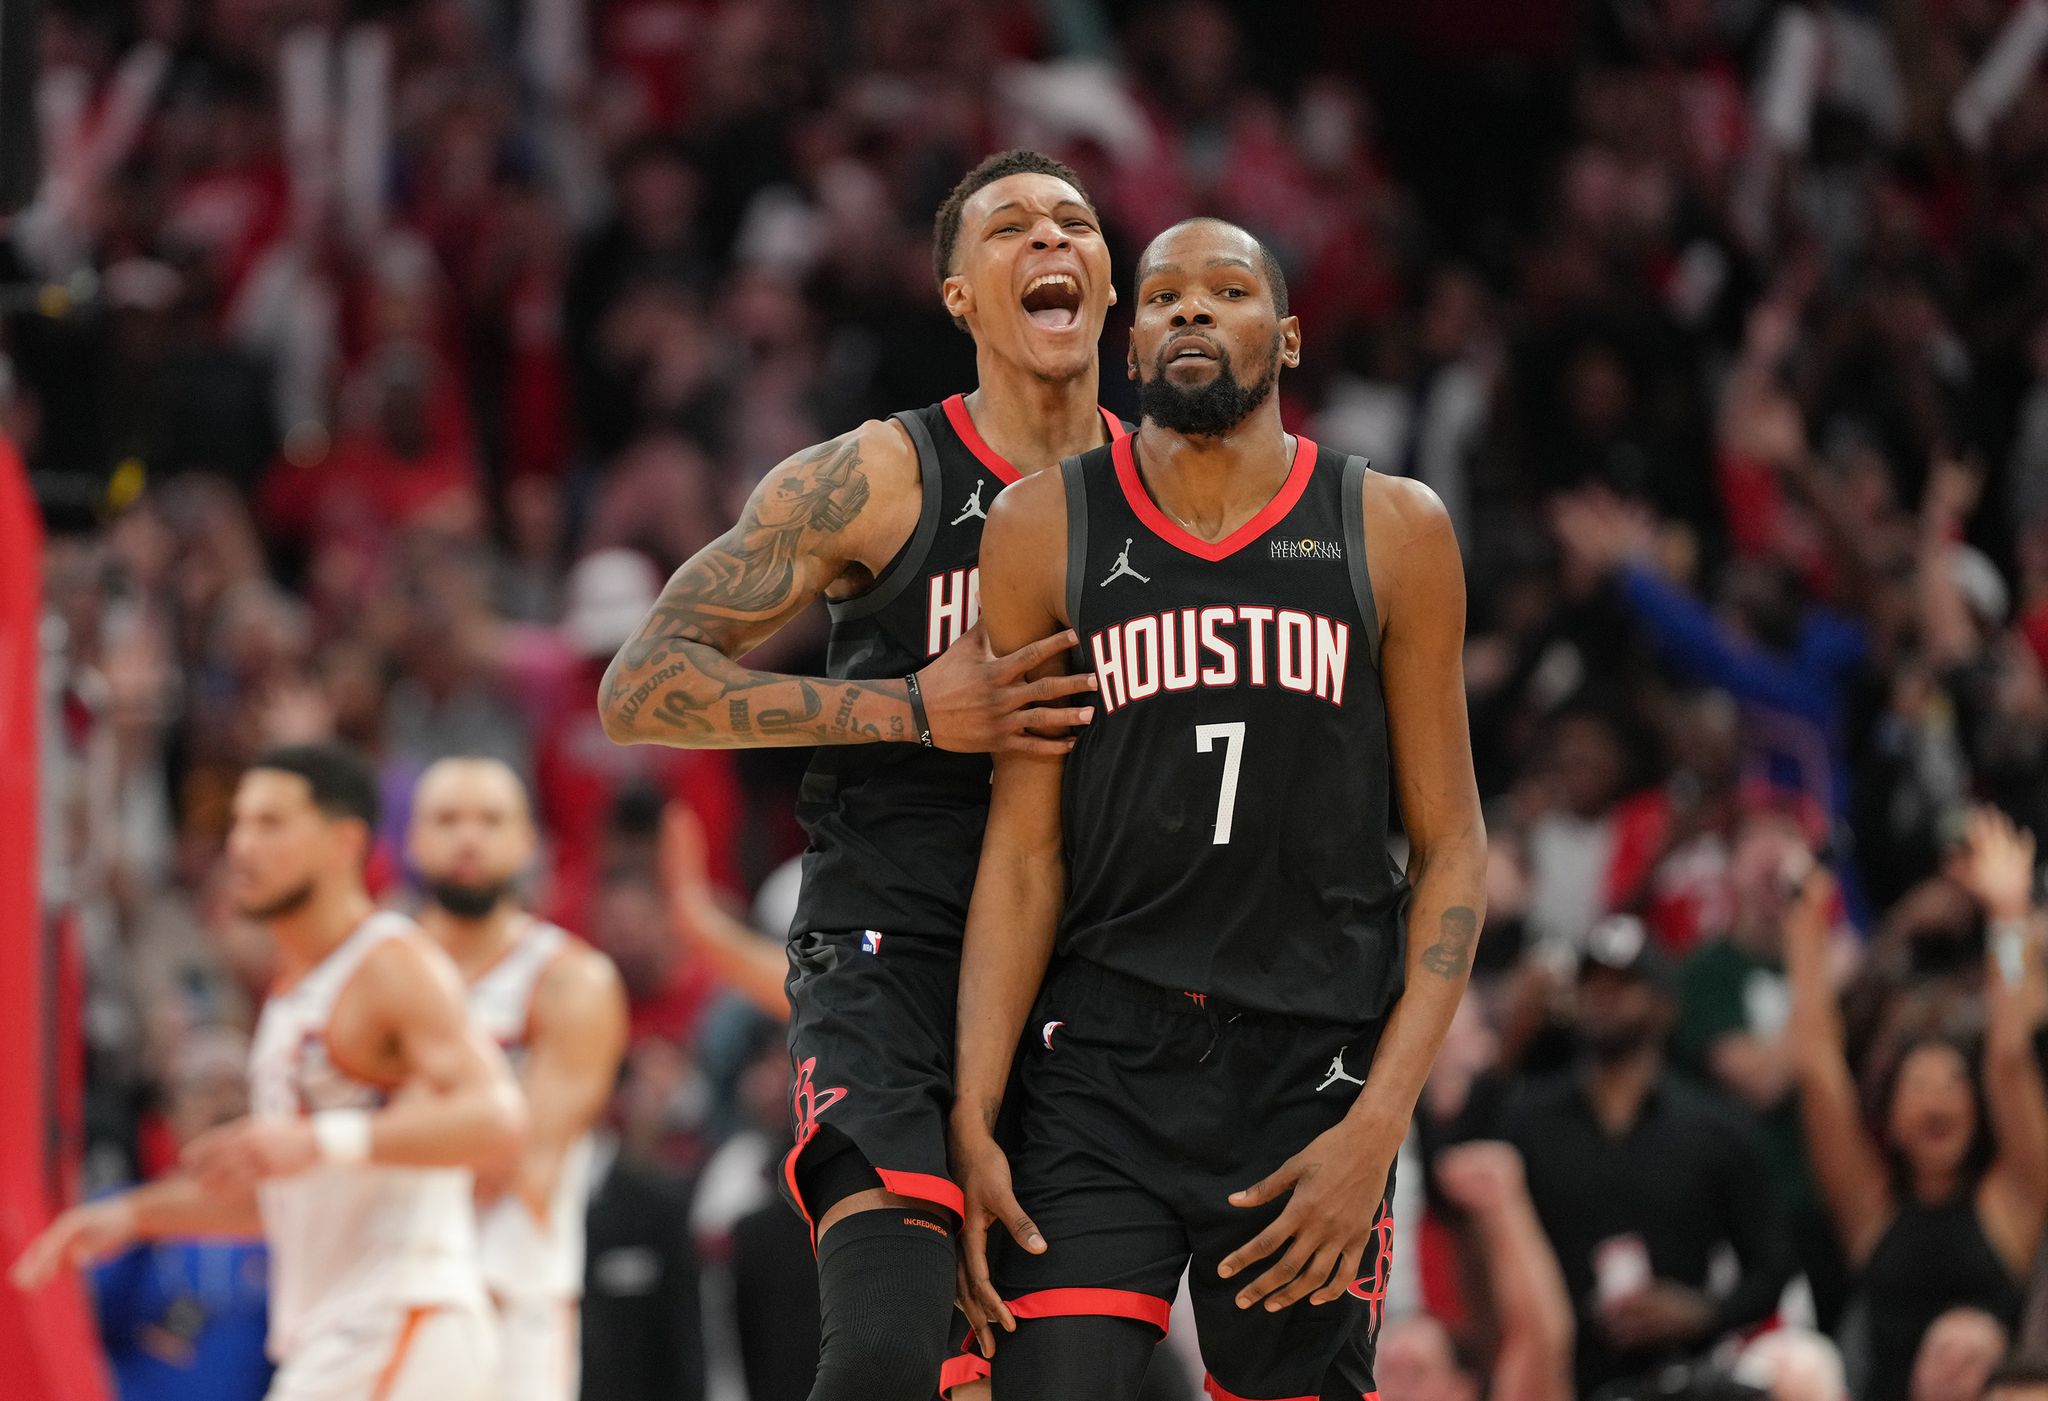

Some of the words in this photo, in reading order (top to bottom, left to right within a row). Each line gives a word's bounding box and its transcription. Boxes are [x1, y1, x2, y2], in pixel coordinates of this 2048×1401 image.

[1270, 538, 1342, 552] MEMORIAL
[1270, 548, 1342, 559] HERMANN
[617, 660, 686, 726] AUBURN
[1090, 605, 1349, 715] HOUSTON
[1195, 721, 1246, 846] 7
